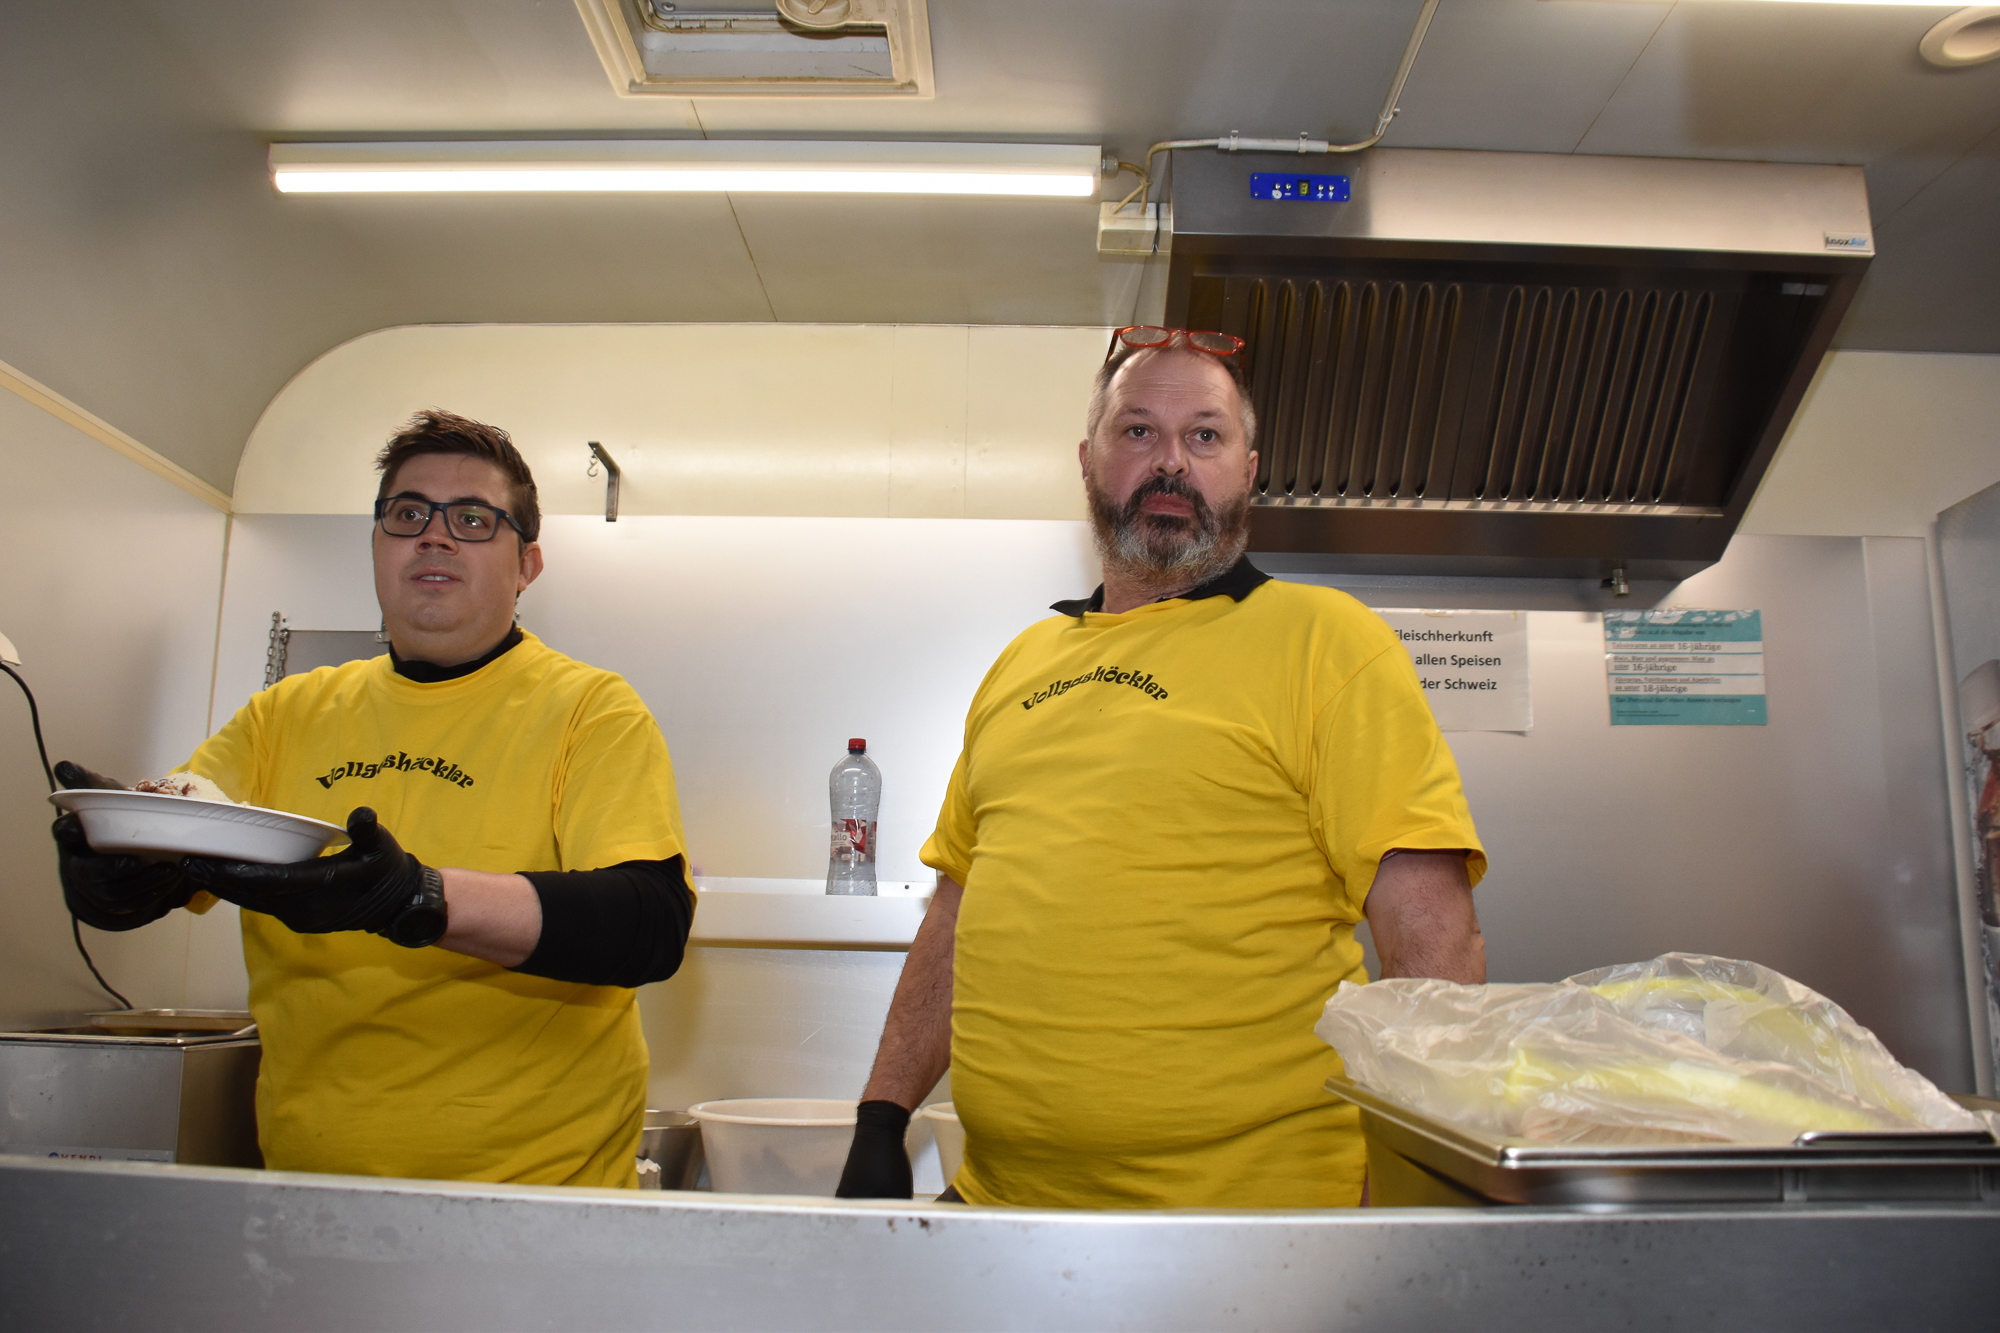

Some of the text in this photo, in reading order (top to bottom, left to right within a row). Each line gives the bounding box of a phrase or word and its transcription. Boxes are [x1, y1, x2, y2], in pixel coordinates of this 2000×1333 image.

[1678, 642, 1722, 652] 16-jährige
[1415, 653, 1501, 668] allen Speisen
[1633, 663, 1677, 673] 16-jährige
[1021, 665, 1169, 710] Vollgashöckler
[1420, 678, 1497, 690] der Schweiz
[1643, 684, 1688, 695] 18-jährige
[315, 751, 474, 789] Vollgshöckler
